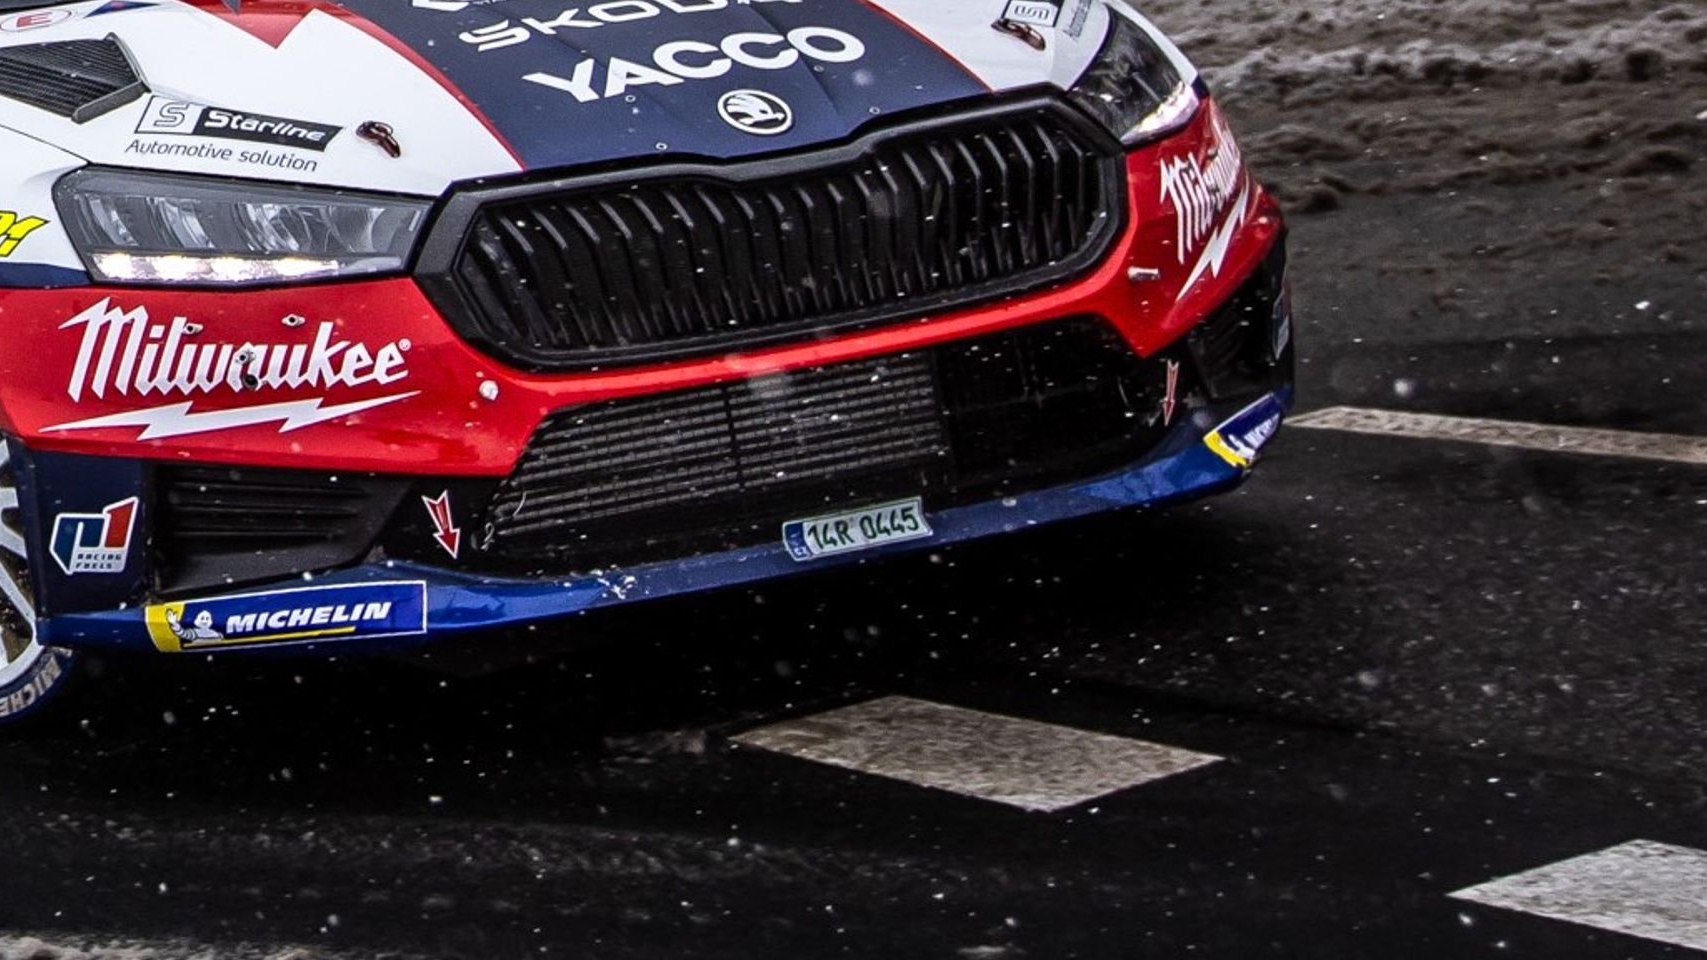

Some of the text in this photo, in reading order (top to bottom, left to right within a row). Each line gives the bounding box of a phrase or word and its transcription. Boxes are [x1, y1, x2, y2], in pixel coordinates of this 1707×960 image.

[522, 26, 866, 103] YACCO
[203, 109, 327, 144] Starline
[124, 138, 318, 174] Automotive solution
[58, 296, 409, 403] Milwaukee
[807, 506, 921, 550] 14R 0445
[225, 600, 392, 636] MICHELIN
